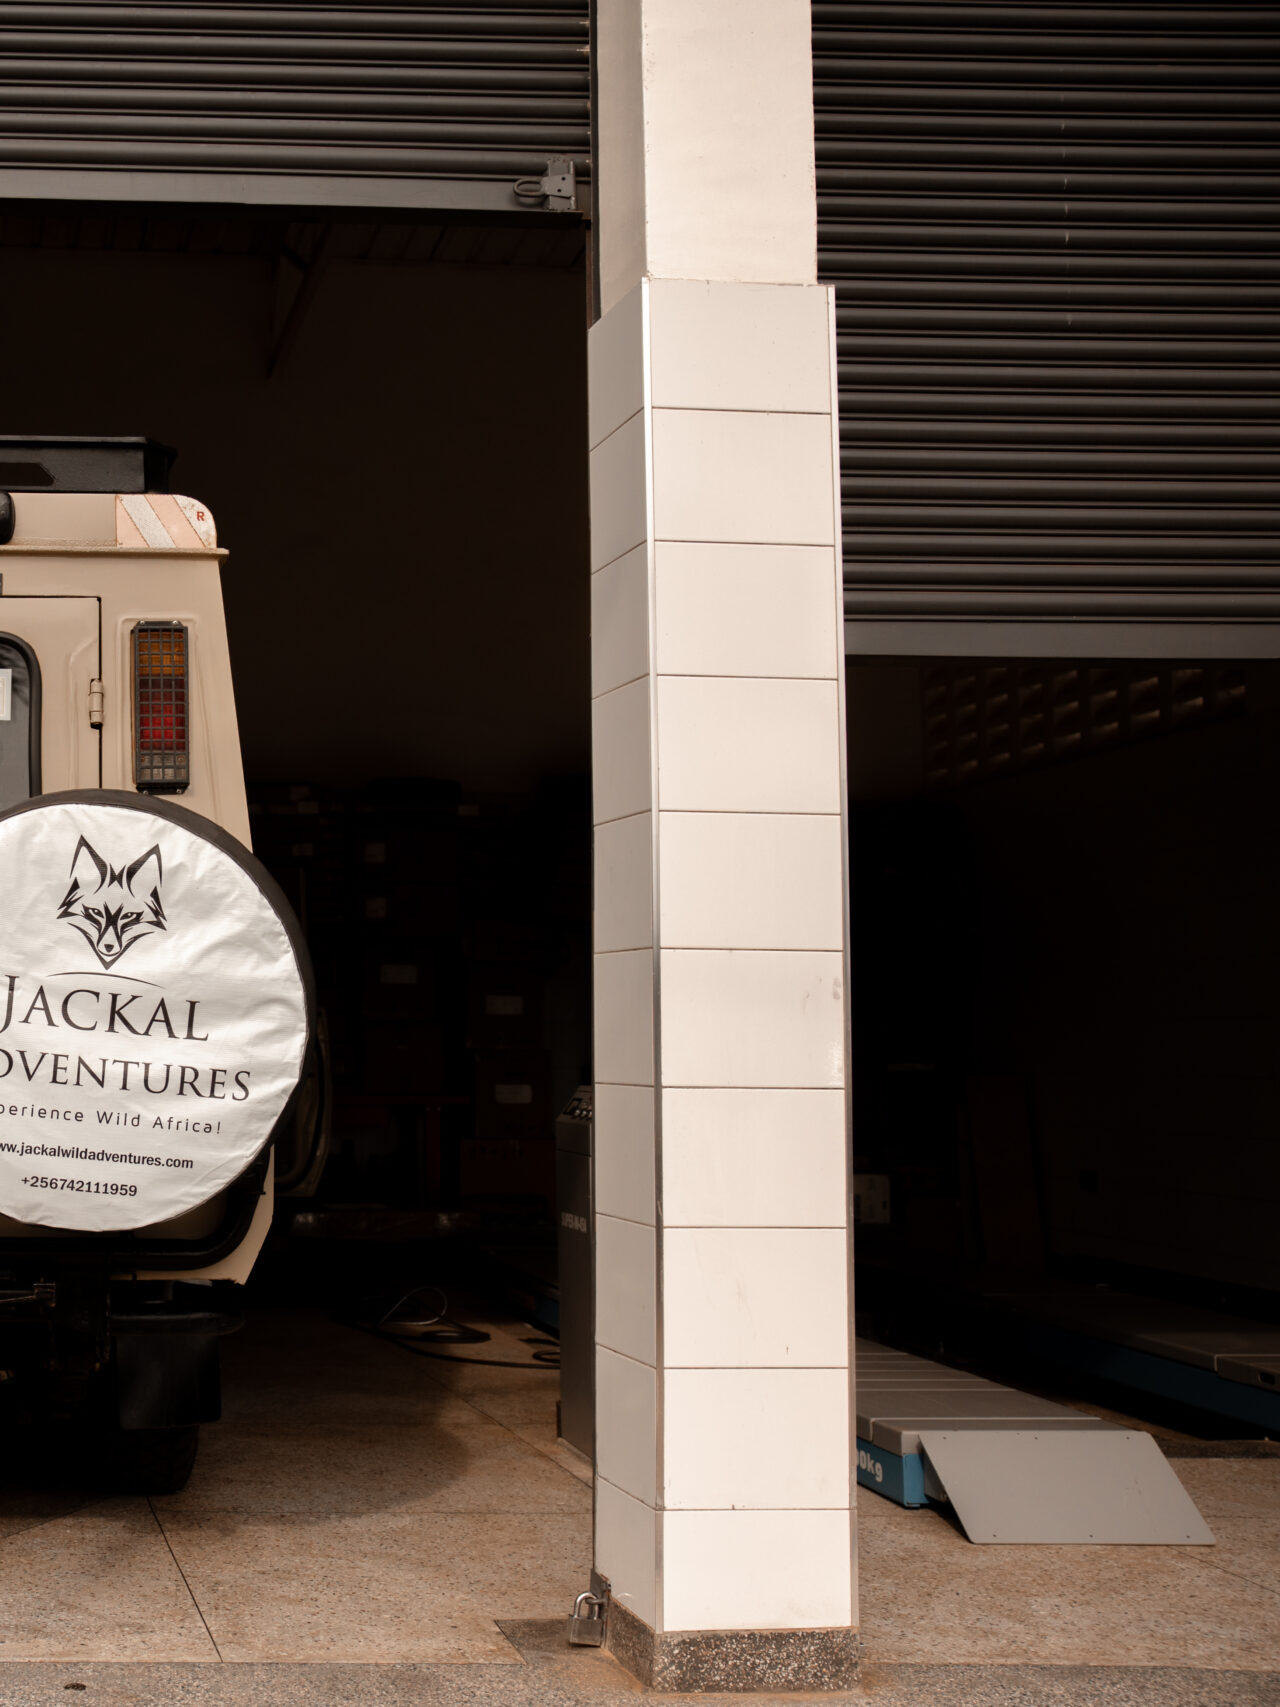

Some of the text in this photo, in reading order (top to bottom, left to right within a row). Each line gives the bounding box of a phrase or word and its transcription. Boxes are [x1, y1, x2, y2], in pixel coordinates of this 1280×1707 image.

[196, 511, 205, 522] R
[96, 1109, 140, 1128] Wild
[152, 1115, 222, 1135] Africa!
[20, 1175, 138, 1197] +256742111959
[856, 1449, 884, 1483] 0kg
